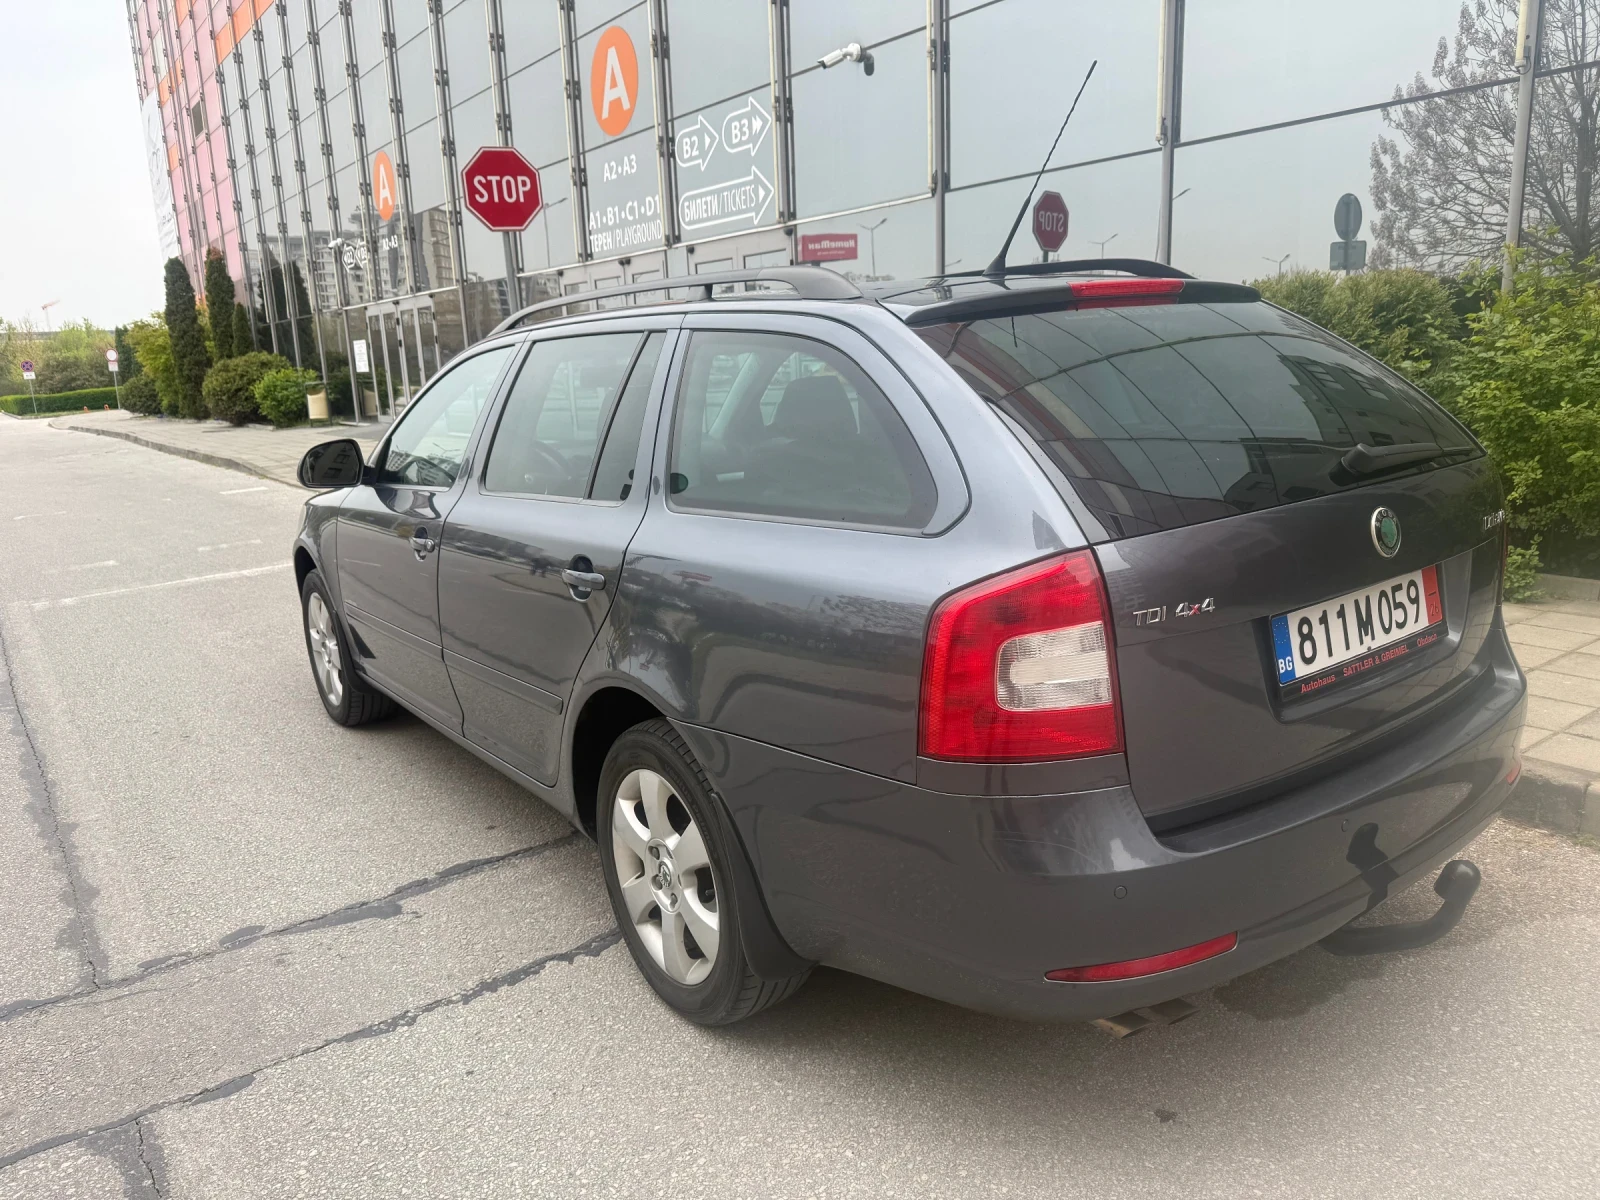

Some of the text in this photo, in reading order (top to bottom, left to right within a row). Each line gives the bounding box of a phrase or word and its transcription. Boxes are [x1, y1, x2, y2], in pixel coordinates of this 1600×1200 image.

[602, 45, 631, 120] A
[731, 118, 750, 144] B3
[682, 135, 699, 159] B2
[379, 163, 393, 211] A
[473, 175, 531, 203] STOP
[1133, 597, 1216, 626] TDI 4x4
[1297, 578, 1420, 666] 811M059
[1278, 655, 1293, 674] BG
[1300, 673, 1336, 694] Autohaus
[1343, 657, 1374, 677] SATTLER
[1374, 655, 1381, 666] &
